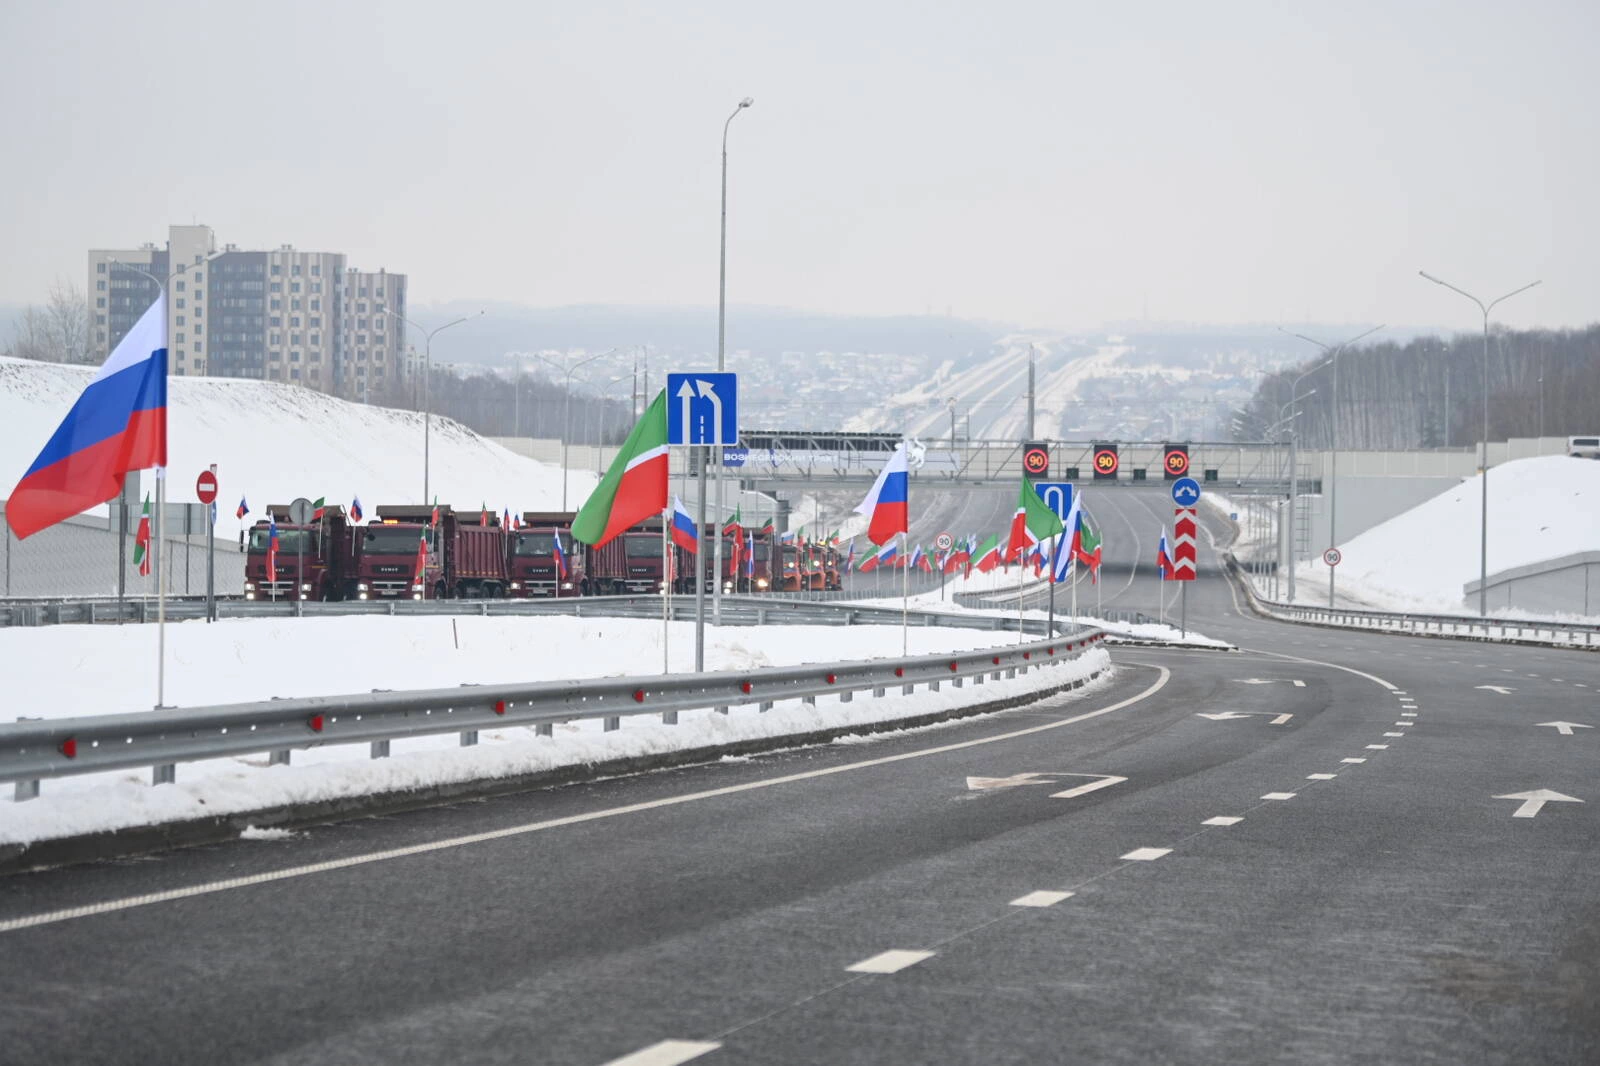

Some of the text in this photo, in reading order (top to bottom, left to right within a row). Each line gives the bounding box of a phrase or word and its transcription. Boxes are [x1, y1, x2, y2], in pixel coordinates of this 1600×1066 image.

[1029, 456, 1042, 466] 90
[1099, 456, 1112, 466] 90
[1169, 457, 1182, 467] 90
[1327, 553, 1338, 561] 90
